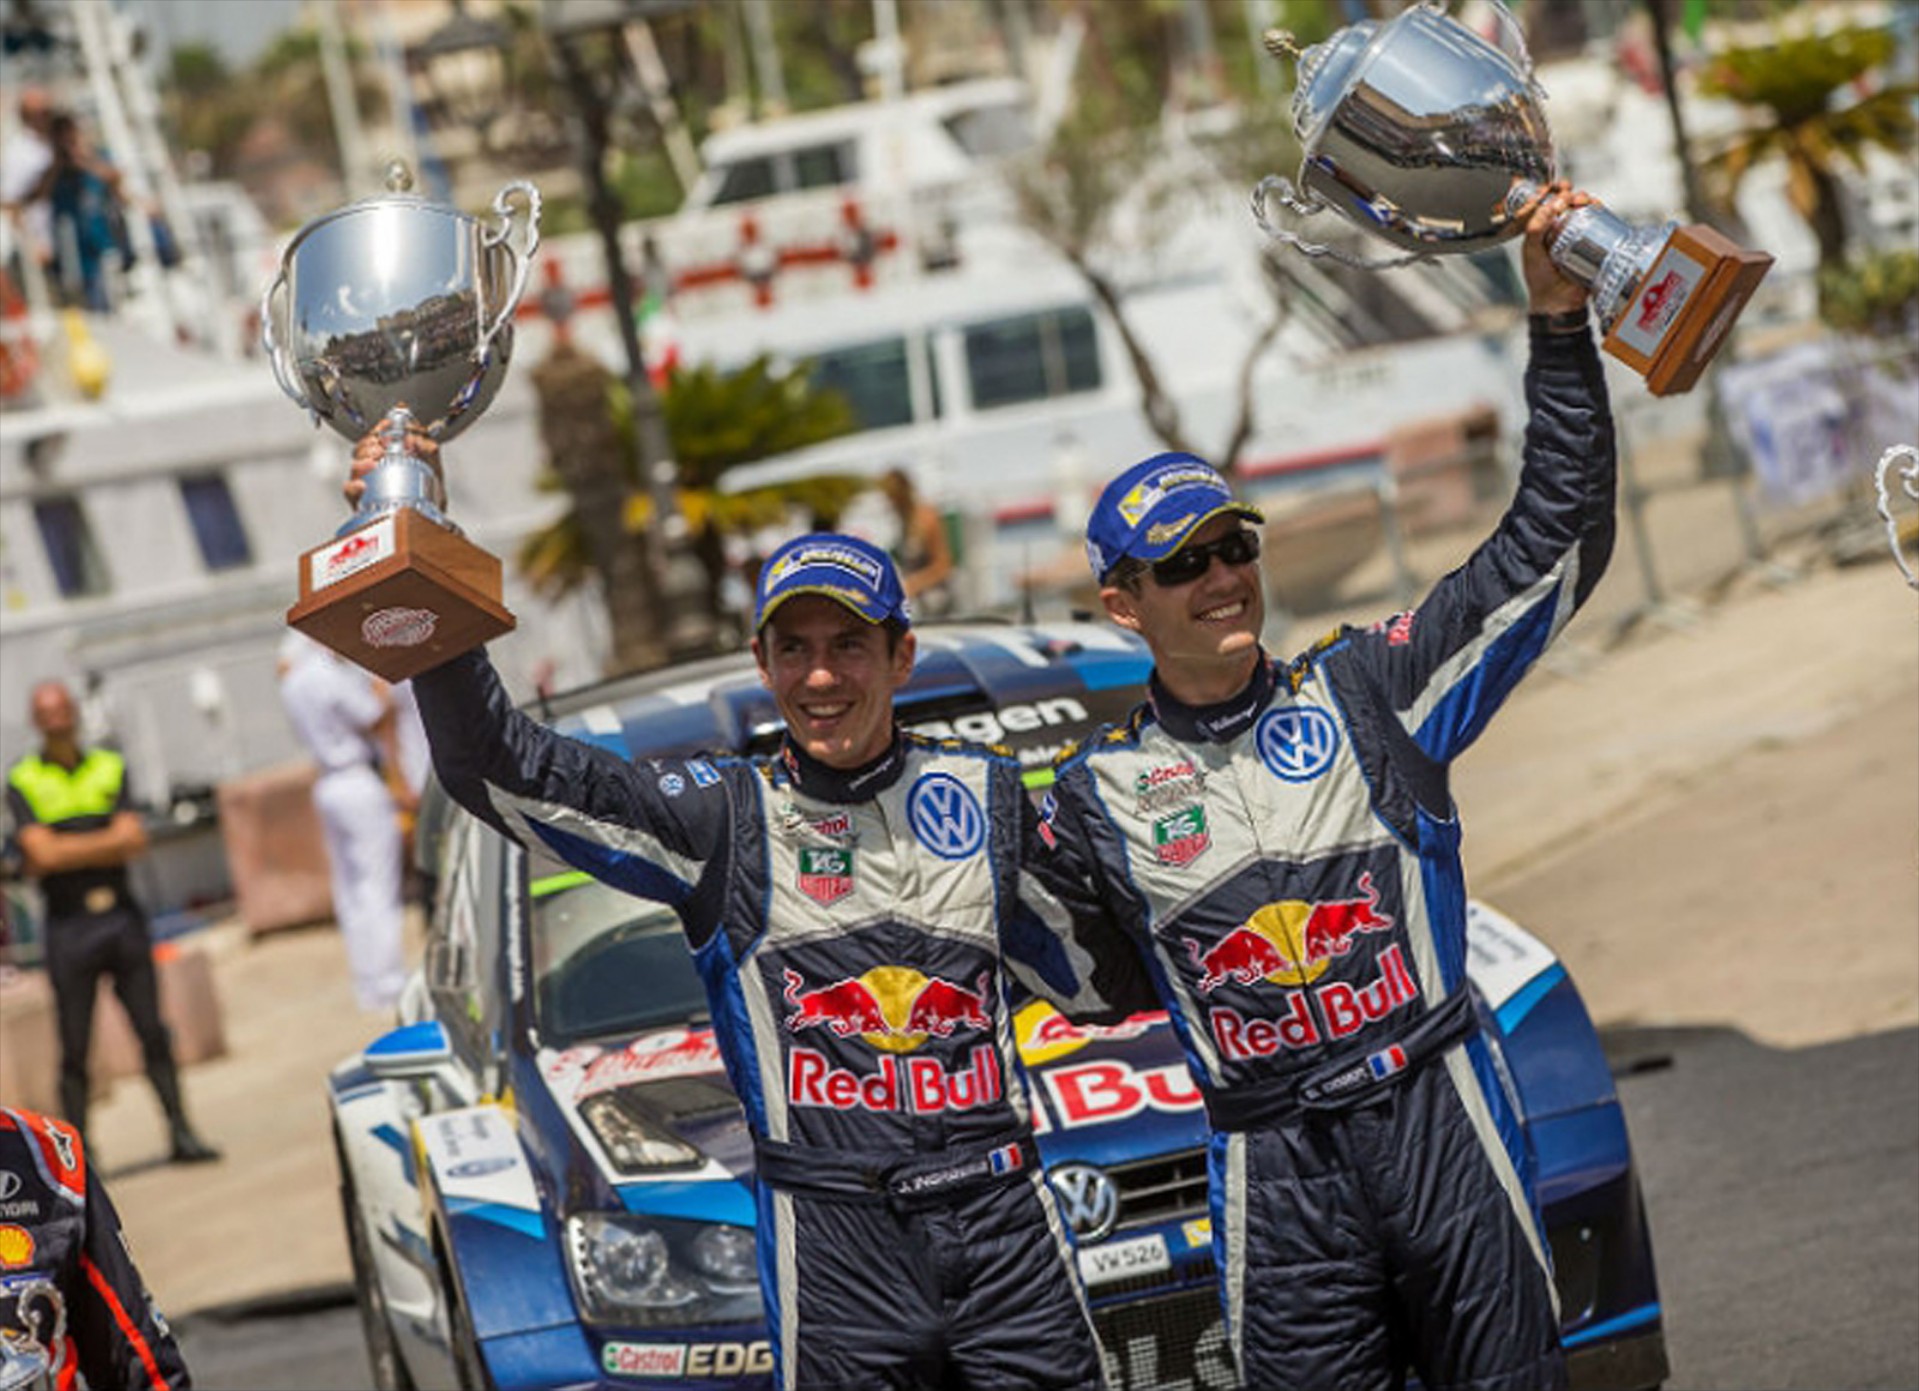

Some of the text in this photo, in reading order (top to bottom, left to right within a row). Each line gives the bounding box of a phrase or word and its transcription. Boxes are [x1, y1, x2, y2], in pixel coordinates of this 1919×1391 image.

[808, 851, 846, 873] TAG
[1210, 989, 1321, 1060] Red
[1316, 943, 1418, 1039] Bull
[789, 1047, 898, 1111] Red
[908, 1043, 1001, 1114] Bull
[619, 1346, 680, 1371] Castrol
